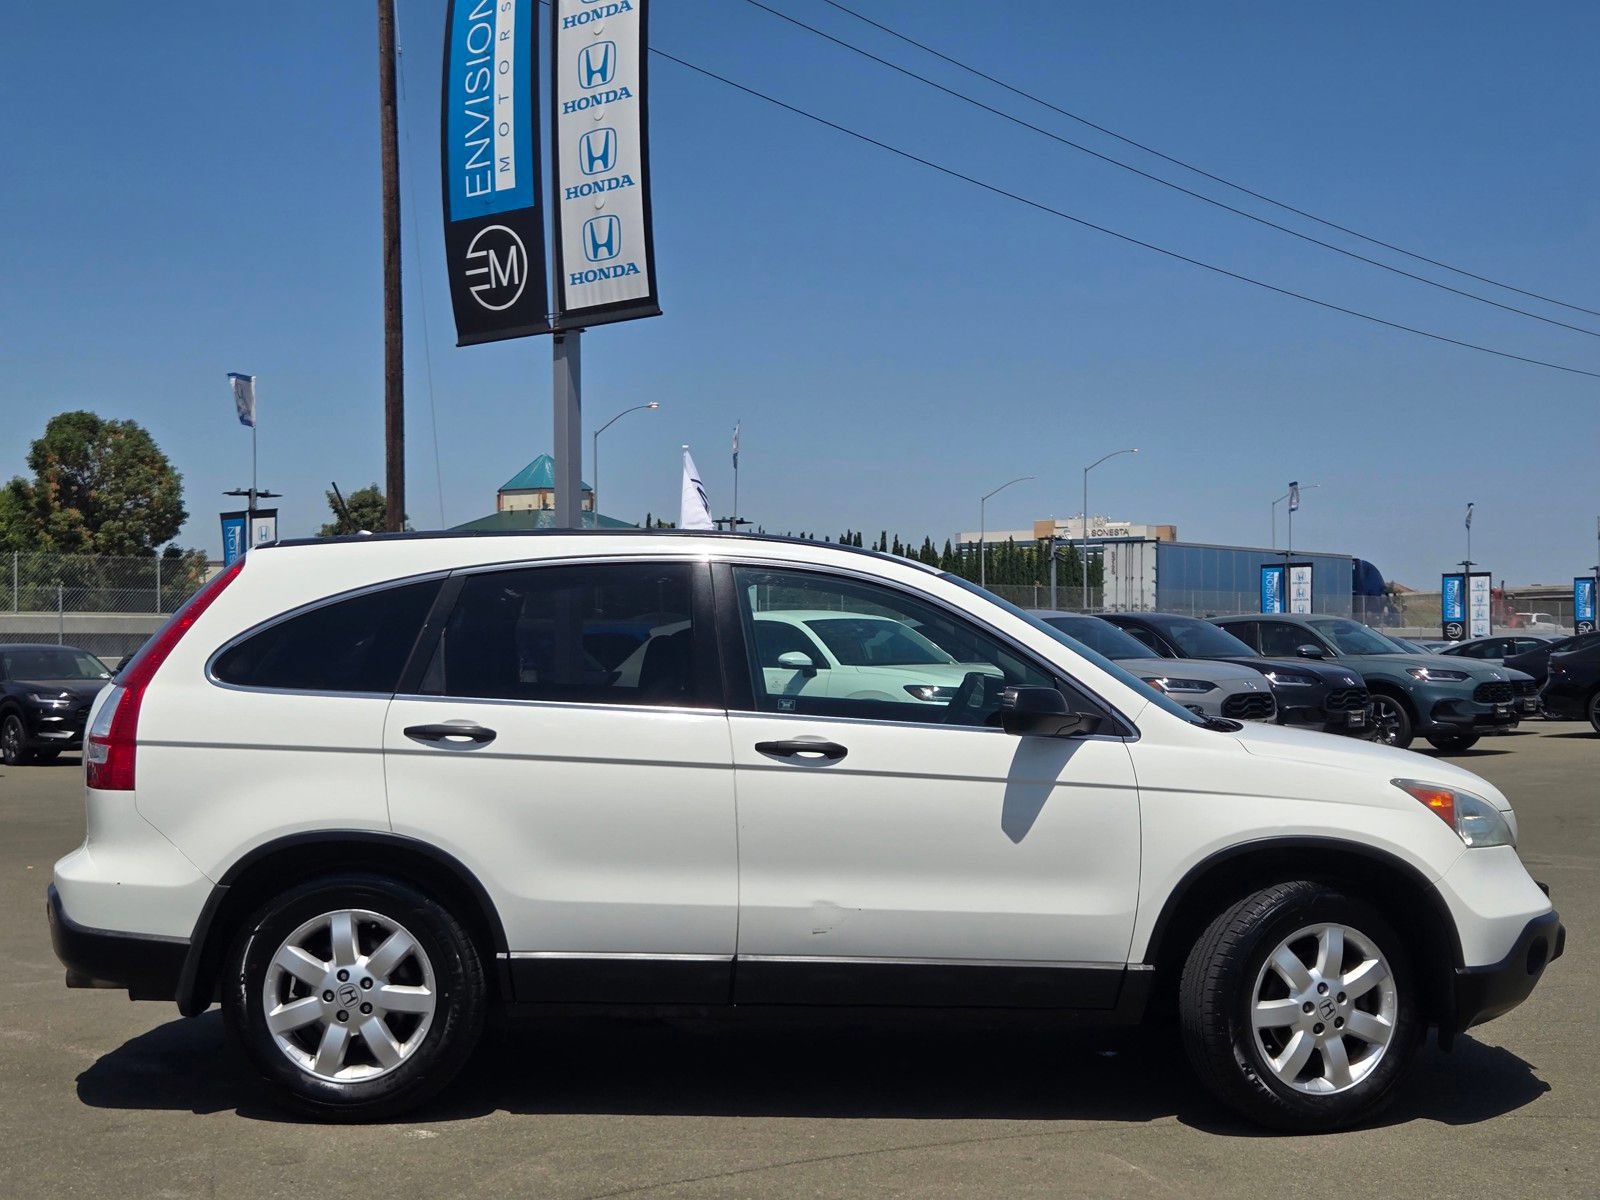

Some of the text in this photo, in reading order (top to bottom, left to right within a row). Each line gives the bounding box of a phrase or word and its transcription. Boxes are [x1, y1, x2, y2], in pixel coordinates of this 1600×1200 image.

[562, 0, 634, 30] HONDA
[499, 1, 512, 173] MOTORS
[562, 86, 633, 115] HONDA
[564, 174, 636, 201] HONDA
[569, 262, 641, 286] HONDA
